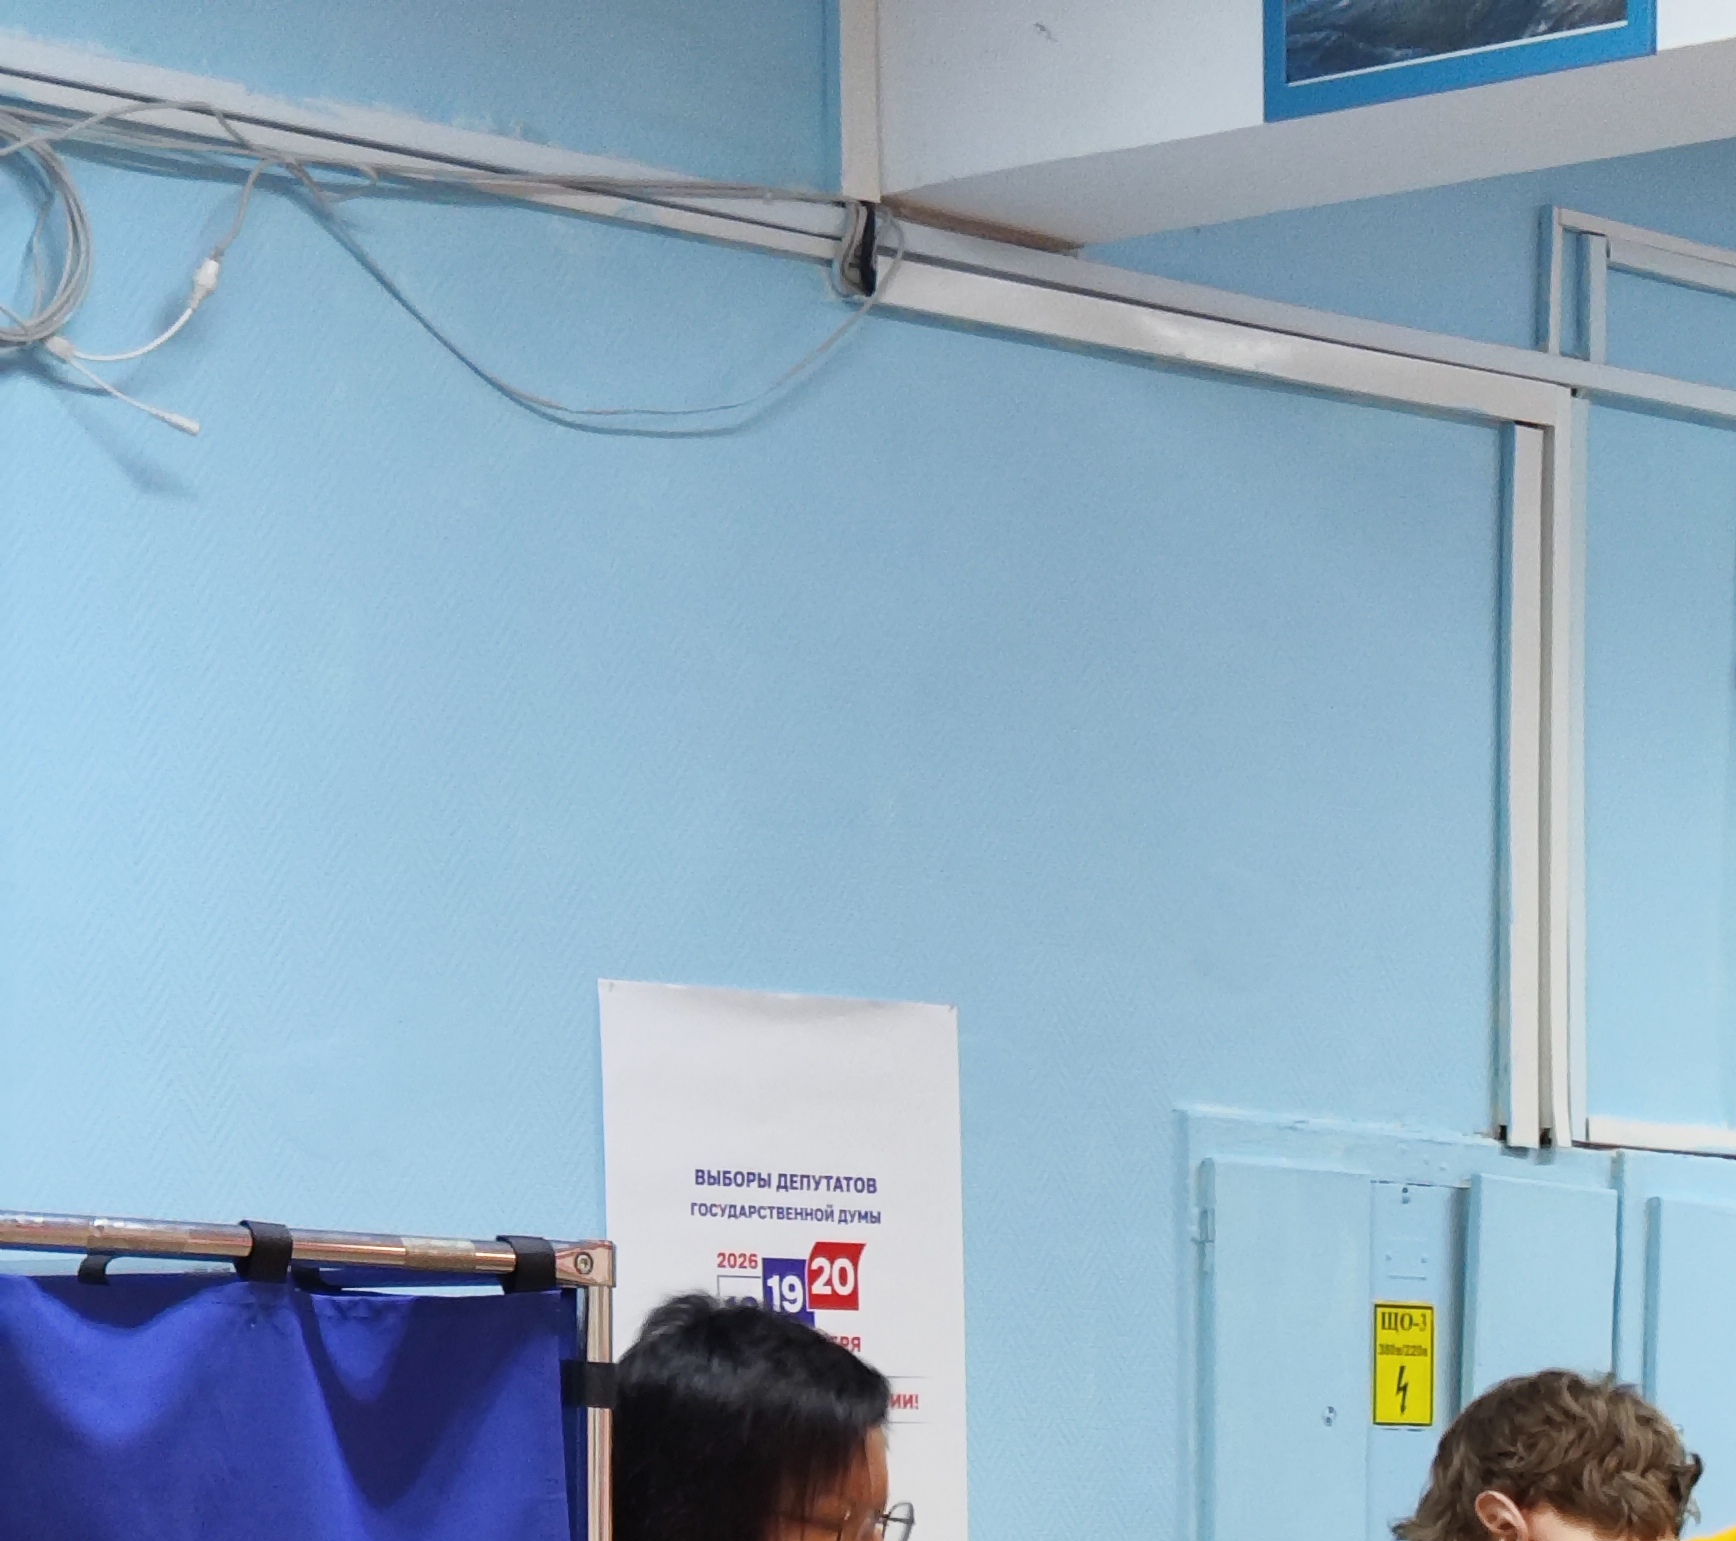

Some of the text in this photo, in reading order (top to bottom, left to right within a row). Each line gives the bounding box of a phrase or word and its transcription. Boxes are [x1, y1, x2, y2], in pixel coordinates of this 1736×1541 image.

[694, 1168, 878, 1194] ВЫБОРЫ ДЕПУТАТОВ
[690, 1201, 882, 1225] ГОСУДАРСТВЕННОЙ ДУМЫ
[717, 1252, 758, 1269] 2026
[767, 1257, 855, 1313] 19 20
[1381, 1311, 1428, 1333] ЩО-3
